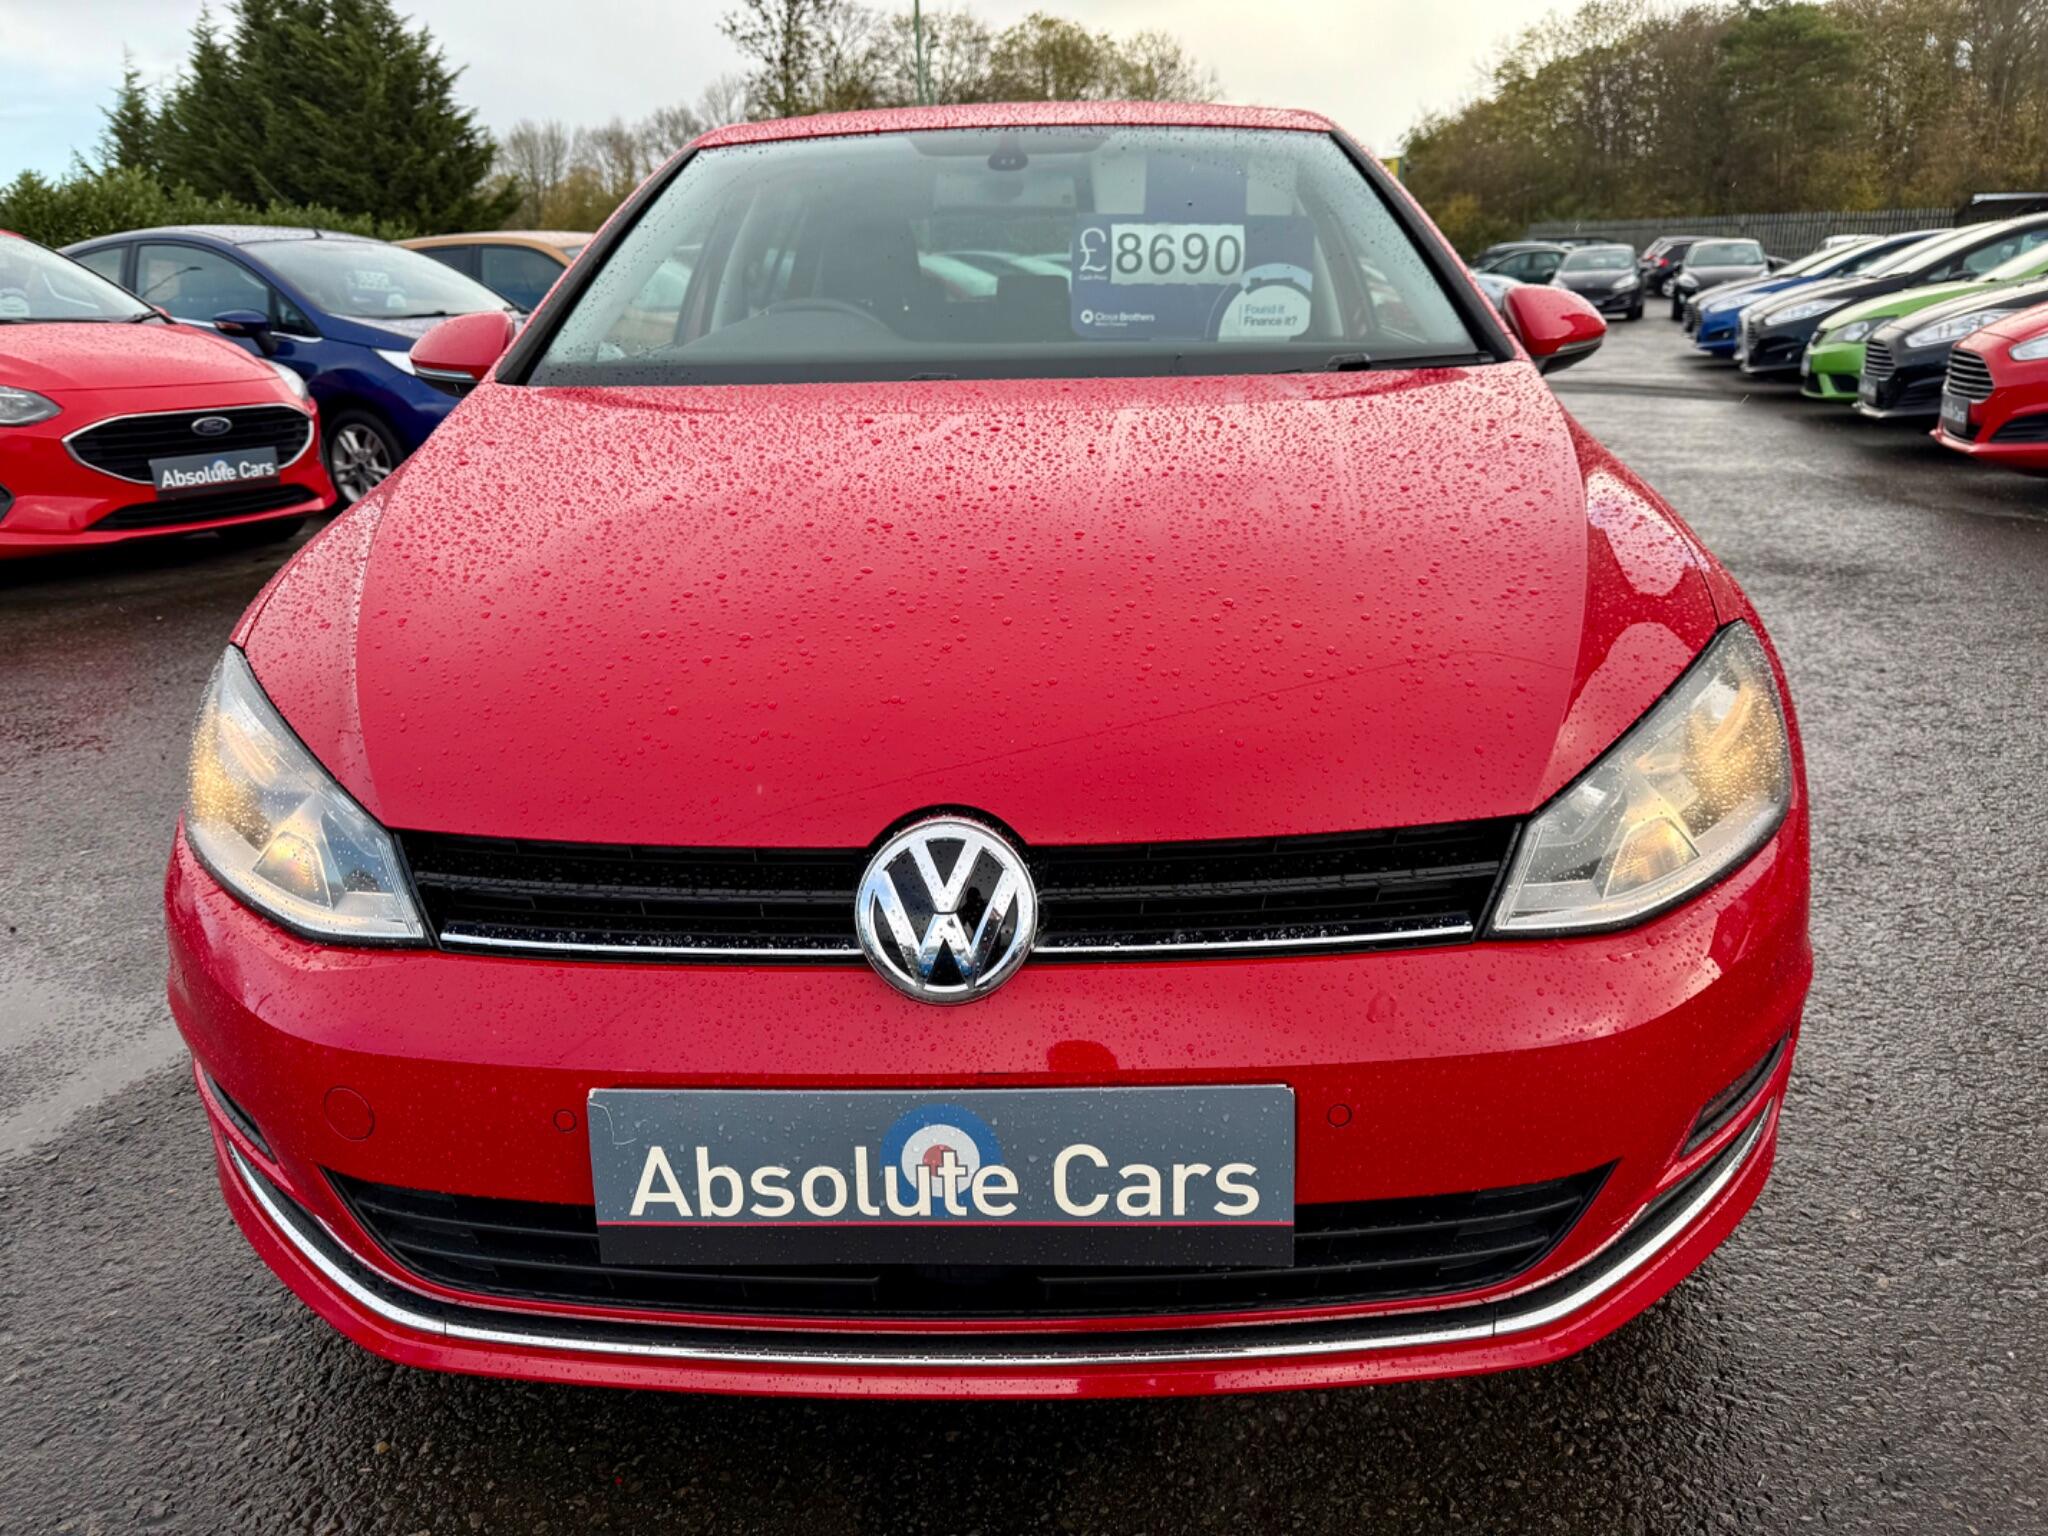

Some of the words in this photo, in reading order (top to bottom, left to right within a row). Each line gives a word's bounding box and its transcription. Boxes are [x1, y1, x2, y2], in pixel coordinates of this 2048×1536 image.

[1245, 304, 1276, 314] Found
[1244, 316, 1282, 326] Finance
[1284, 315, 1298, 326] it?
[162, 465, 236, 488] Absolute
[239, 461, 275, 478] Cars
[629, 1145, 1019, 1218] Absolute
[1053, 1143, 1261, 1217] Cars
